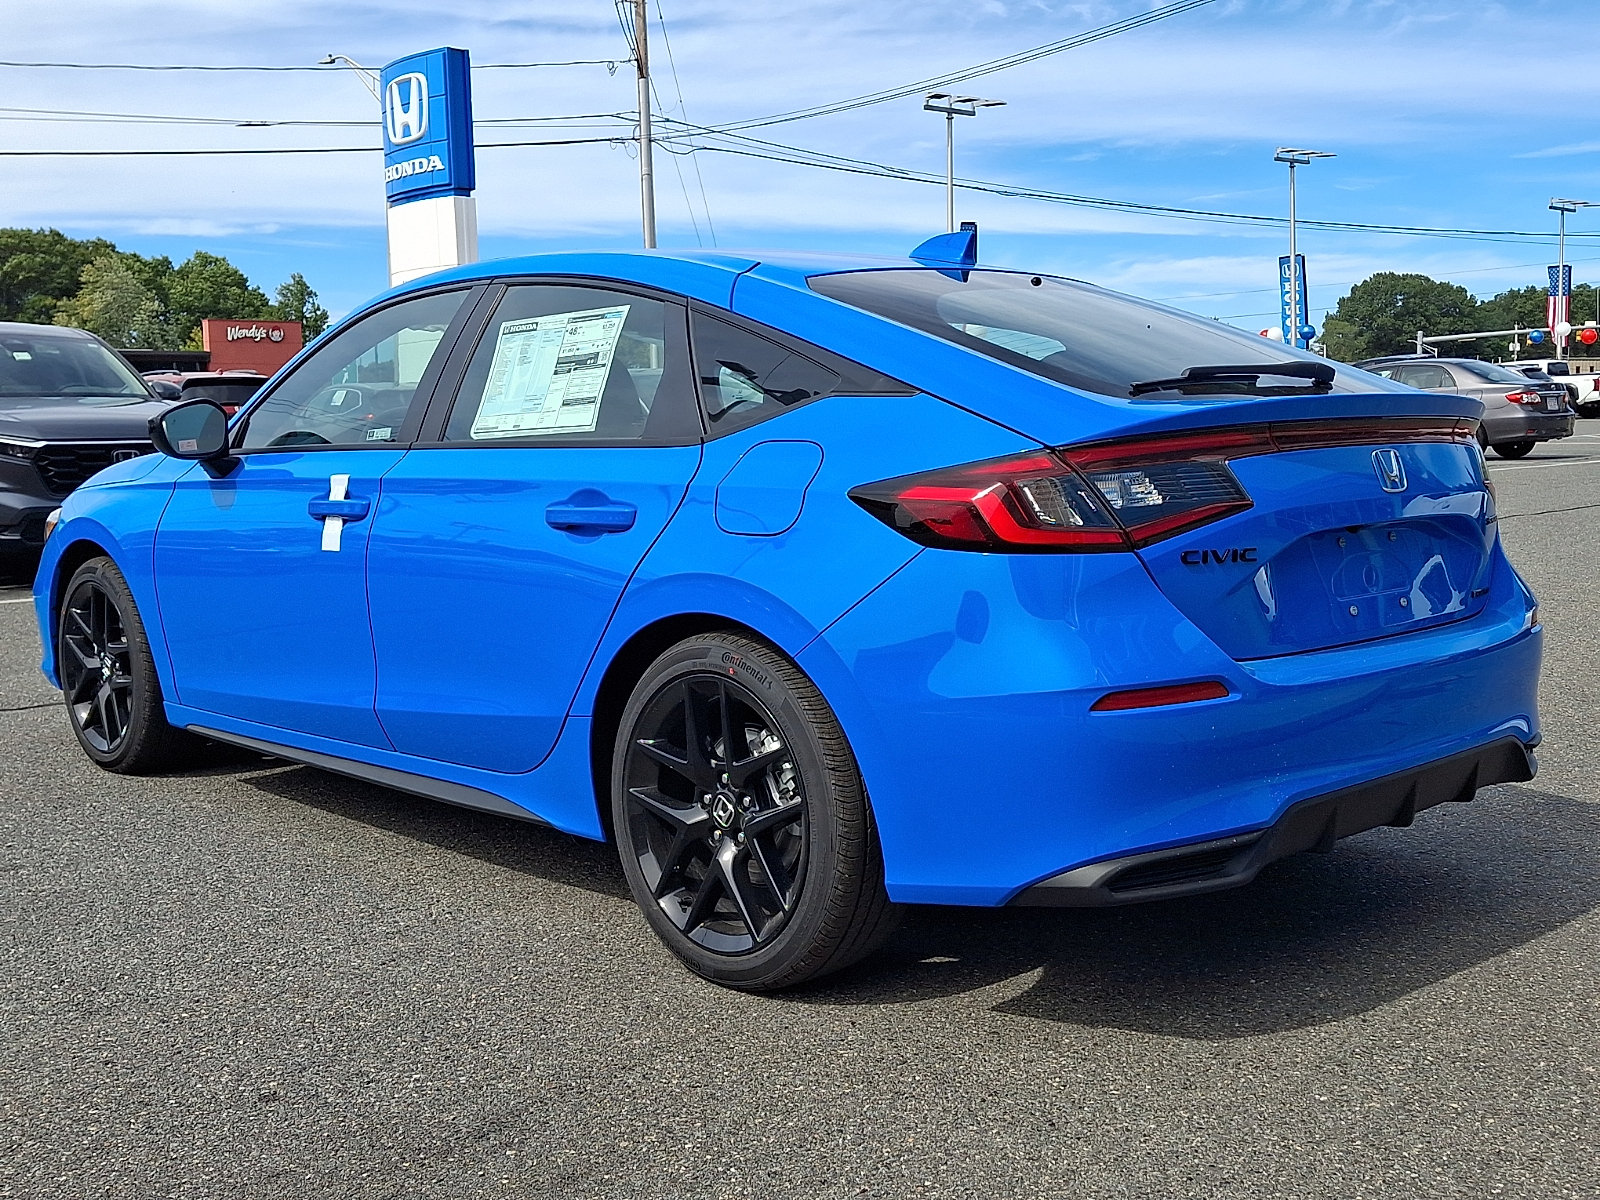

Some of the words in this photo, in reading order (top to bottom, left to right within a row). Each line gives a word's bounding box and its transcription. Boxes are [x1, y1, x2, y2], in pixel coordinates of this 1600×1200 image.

[385, 155, 445, 183] HONDA
[227, 324, 267, 342] Wendy's
[510, 323, 537, 332] HONDA
[1180, 547, 1258, 565] CIVIC
[721, 651, 767, 685] Continental
